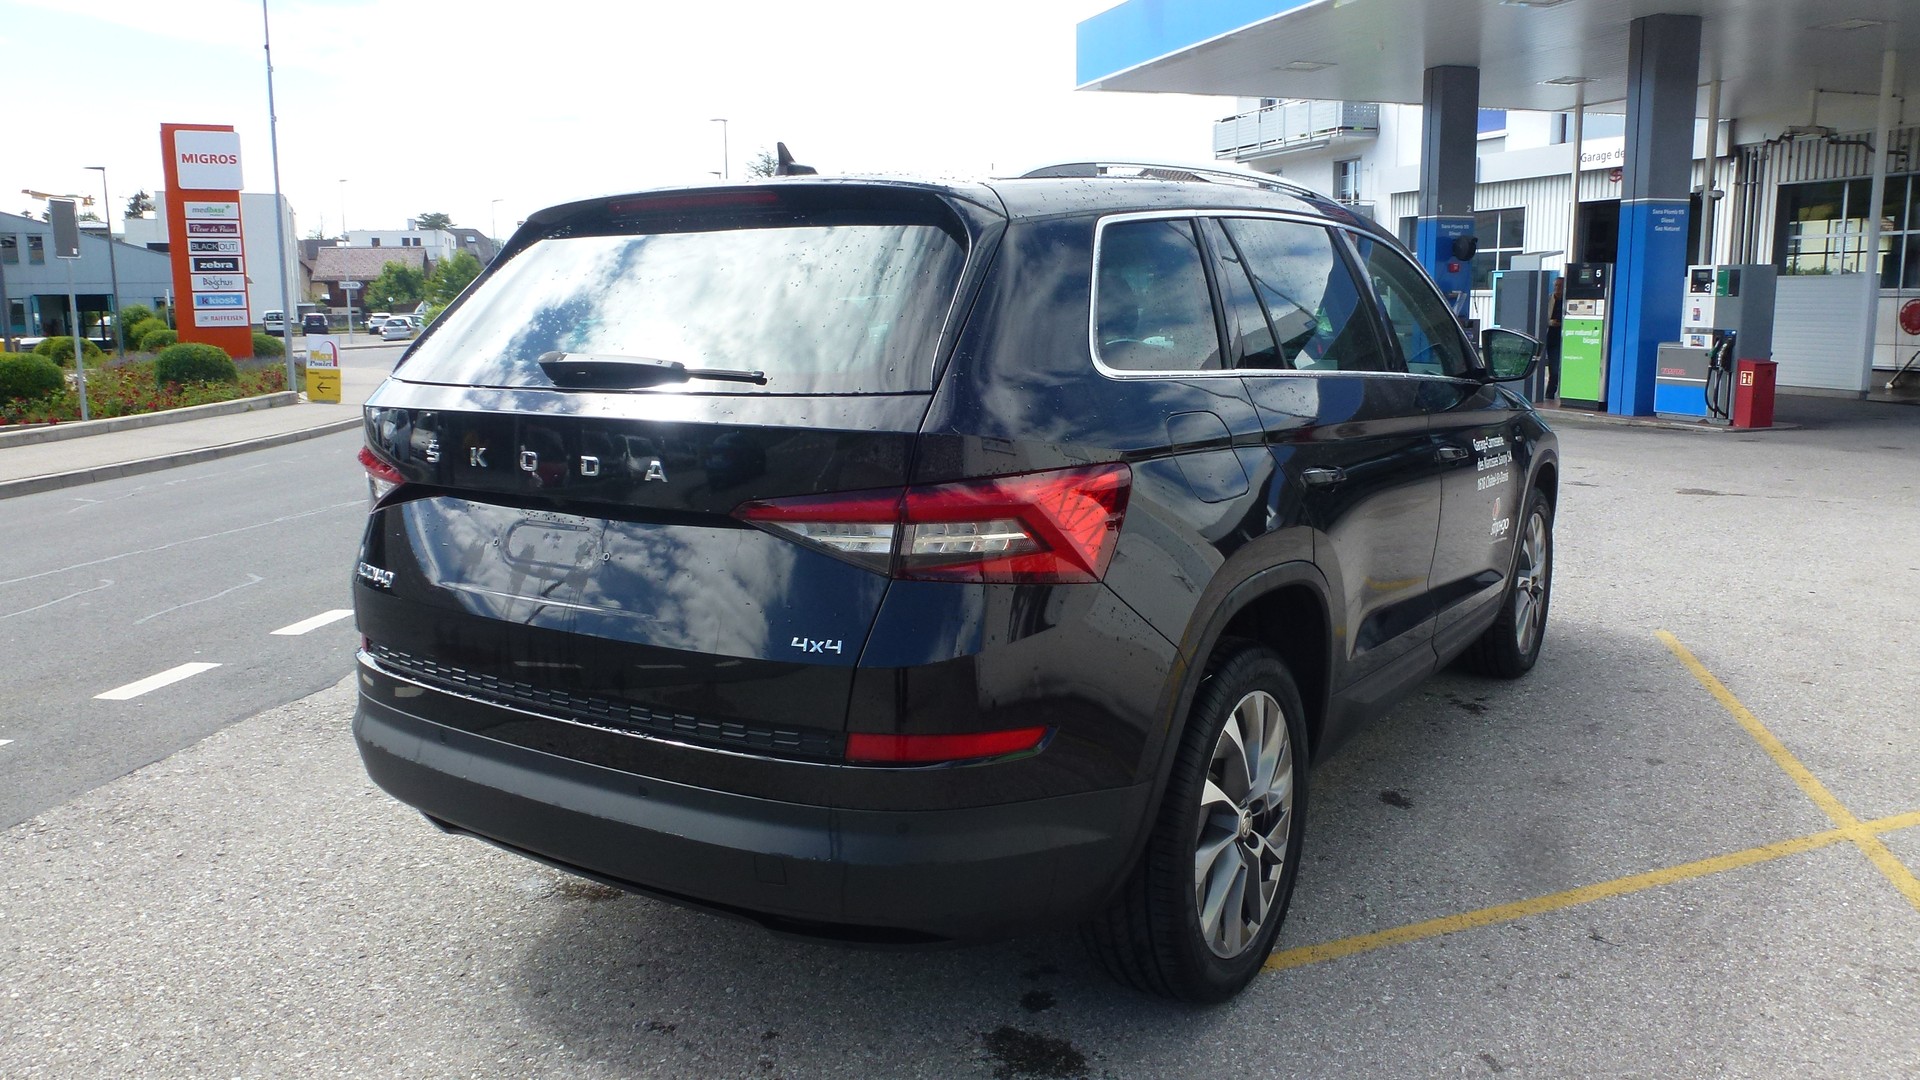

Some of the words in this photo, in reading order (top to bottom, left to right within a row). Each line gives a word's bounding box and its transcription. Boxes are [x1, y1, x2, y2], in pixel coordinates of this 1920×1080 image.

[181, 153, 237, 164] MIGROS
[1581, 152, 1611, 163] Garage
[1439, 204, 1443, 212] 1
[200, 261, 234, 269] zebra
[1595, 269, 1602, 278] 5
[1704, 283, 1711, 292] 3
[791, 637, 842, 654] 4x4
